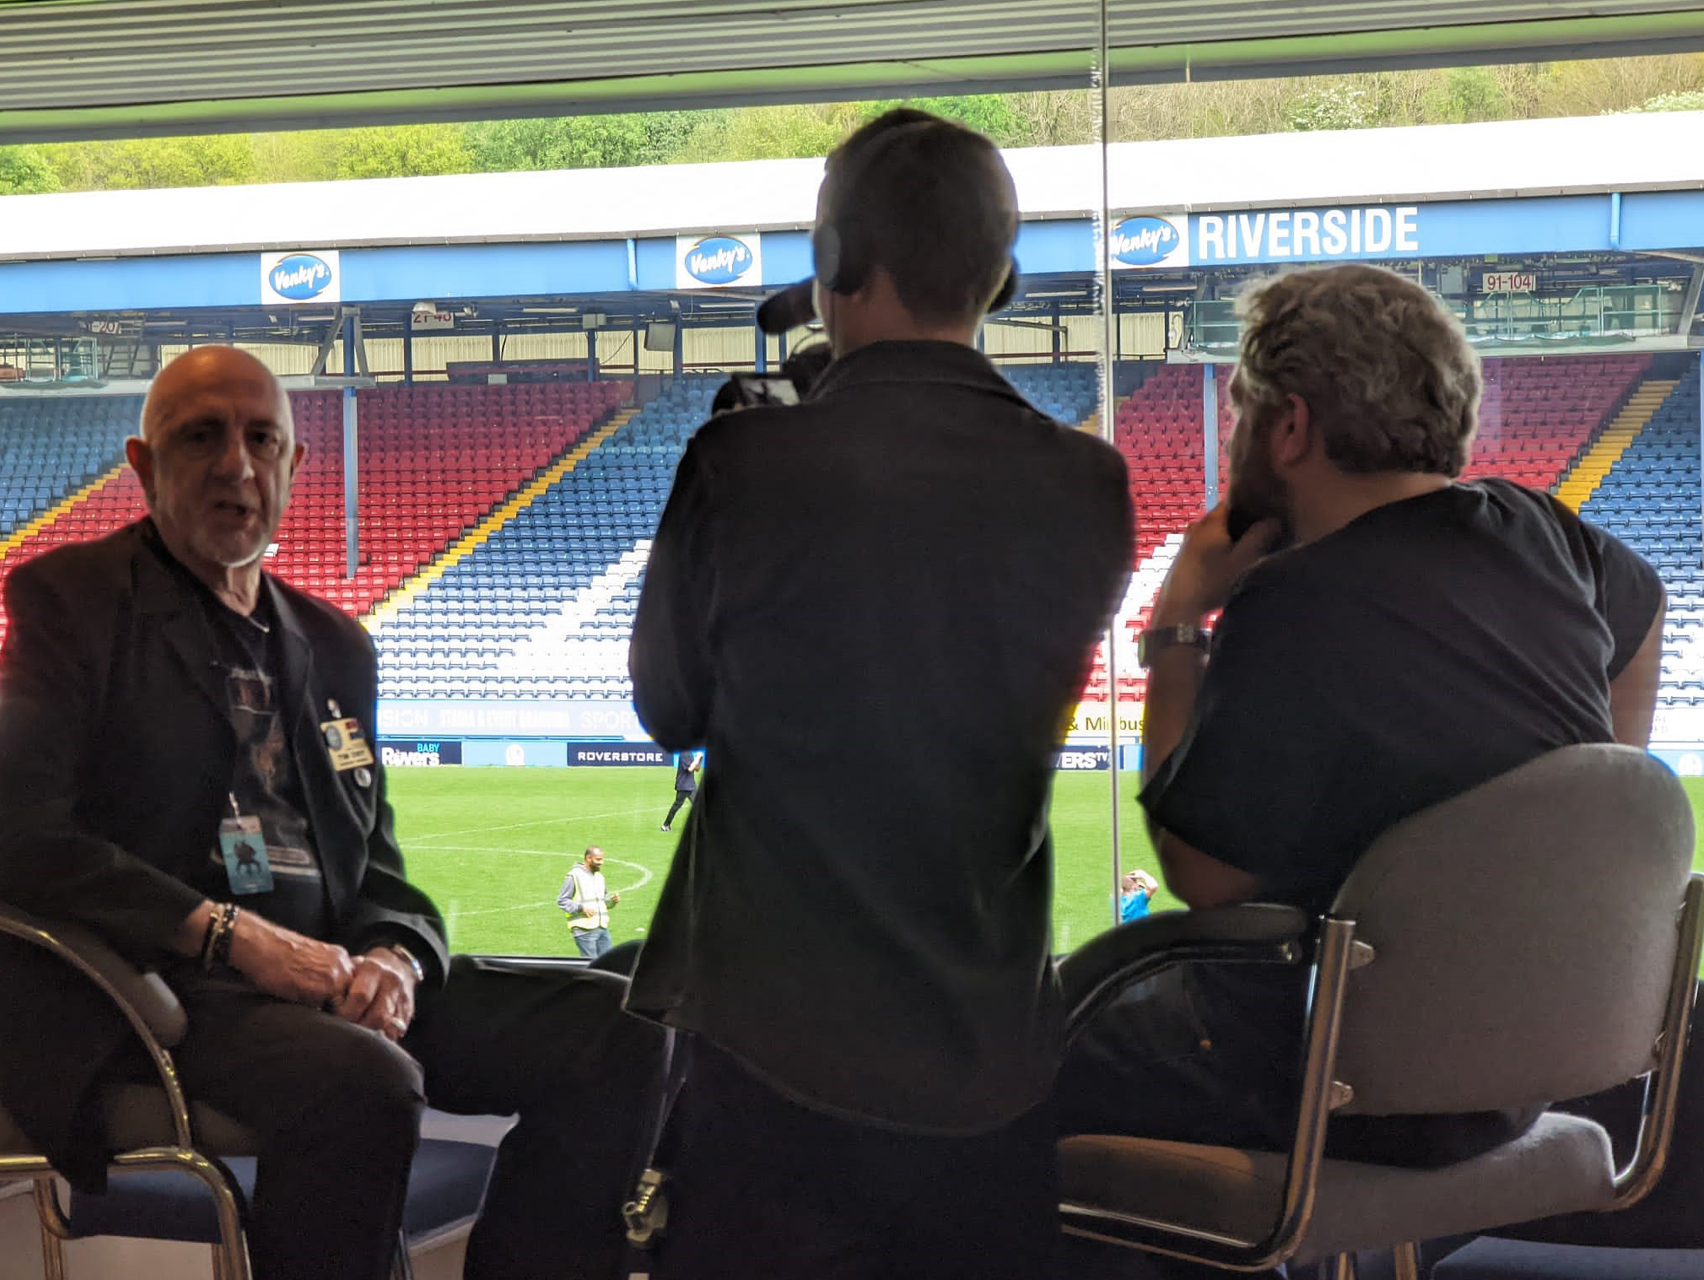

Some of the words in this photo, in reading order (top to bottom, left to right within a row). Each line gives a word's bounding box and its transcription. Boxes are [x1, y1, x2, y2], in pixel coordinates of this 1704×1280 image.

[1199, 207, 1418, 259] RIVERSIDE
[691, 246, 750, 276] Venky's
[274, 263, 329, 291] Venky's
[1487, 274, 1531, 290] 91-104
[1085, 716, 1144, 731] Mibus
[417, 743, 440, 752] BABY
[577, 751, 664, 762] ROVERSTORE
[381, 747, 440, 767] Rovers
